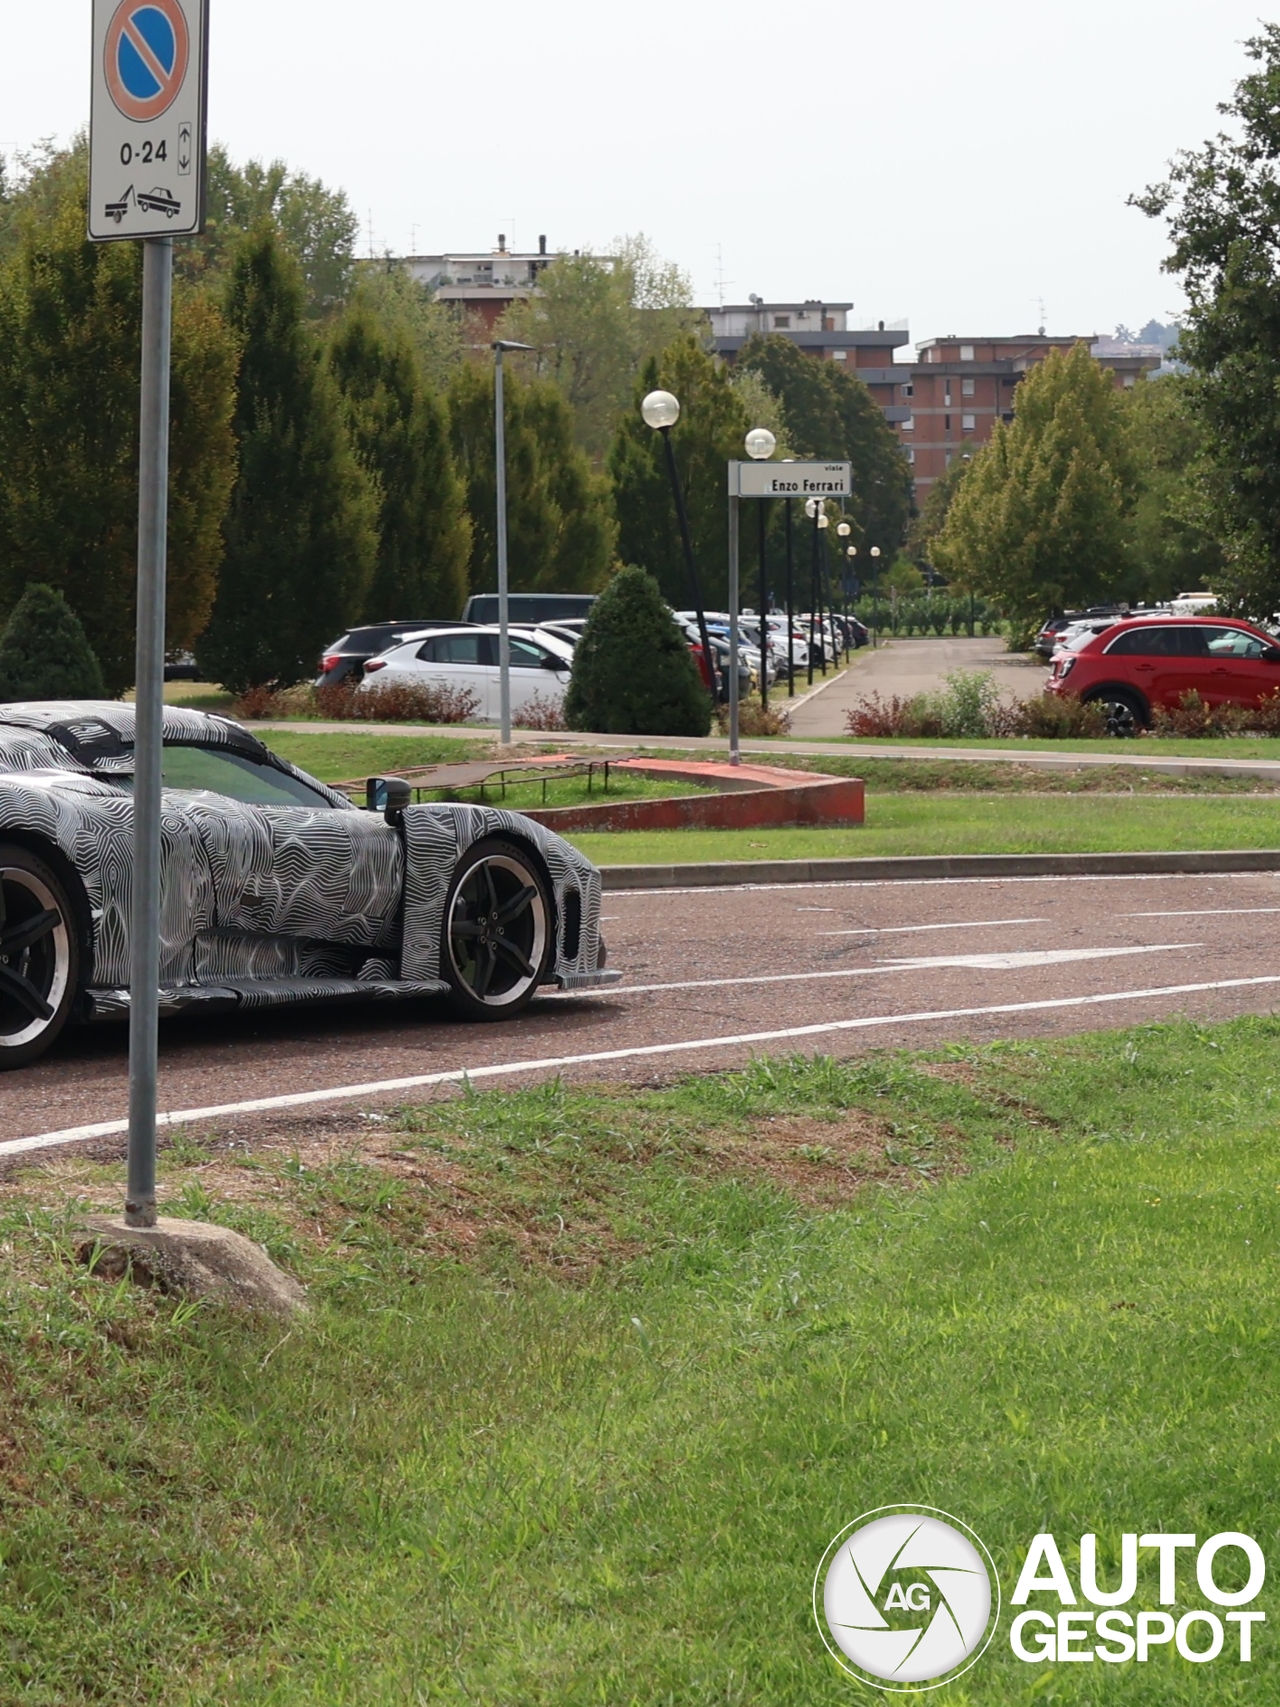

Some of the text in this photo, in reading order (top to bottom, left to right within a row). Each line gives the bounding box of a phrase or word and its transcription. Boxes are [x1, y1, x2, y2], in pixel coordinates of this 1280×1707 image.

[120, 140, 167, 166] 0-24
[772, 479, 844, 491] Enzo Ferrari
